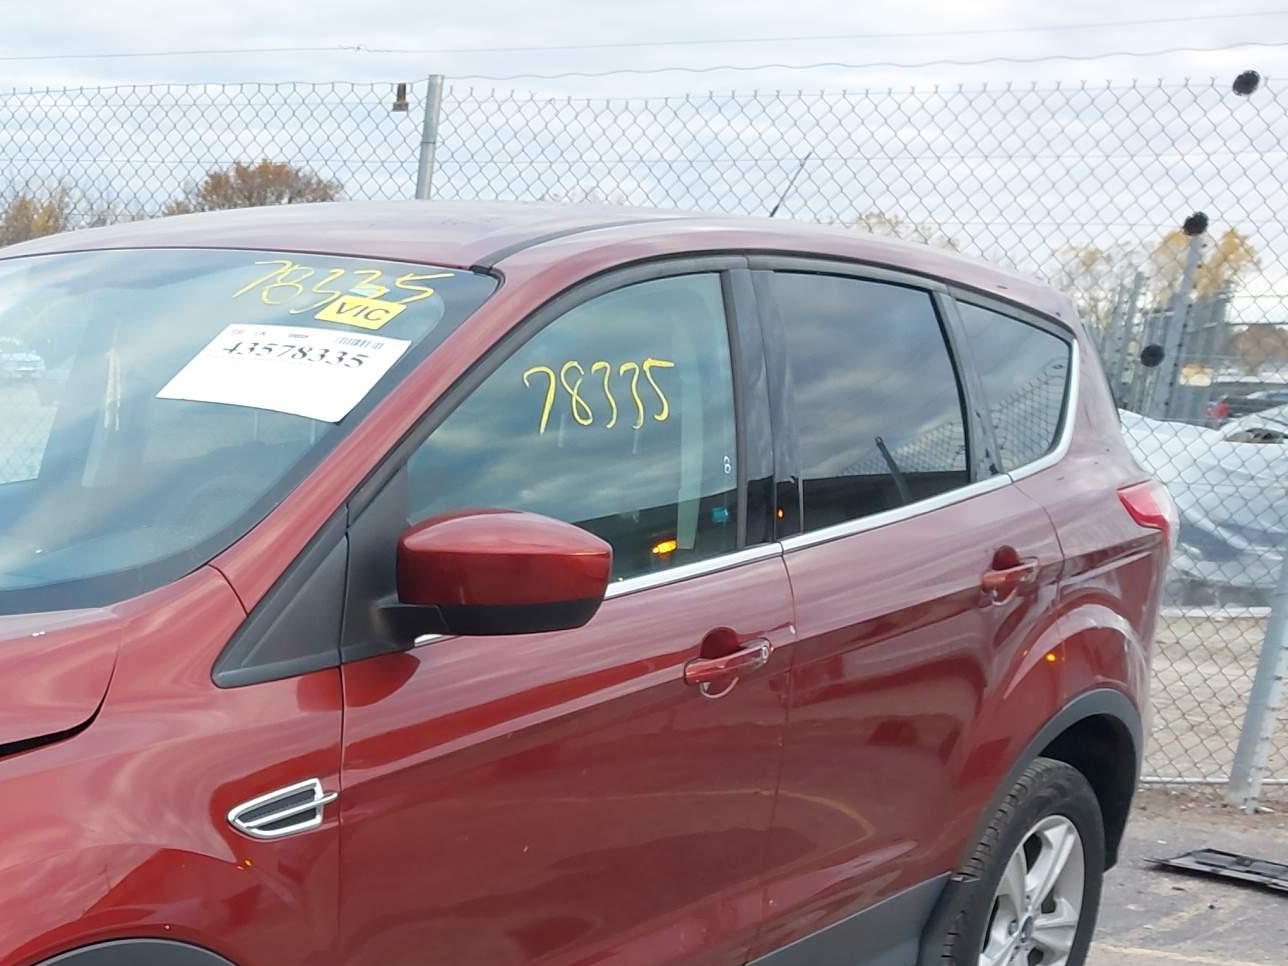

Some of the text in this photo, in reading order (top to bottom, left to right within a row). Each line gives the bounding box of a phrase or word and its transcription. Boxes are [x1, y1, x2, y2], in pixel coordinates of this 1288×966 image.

[334, 301, 392, 322] VIC
[223, 341, 373, 369] 43578335
[522, 358, 675, 436] 78335
